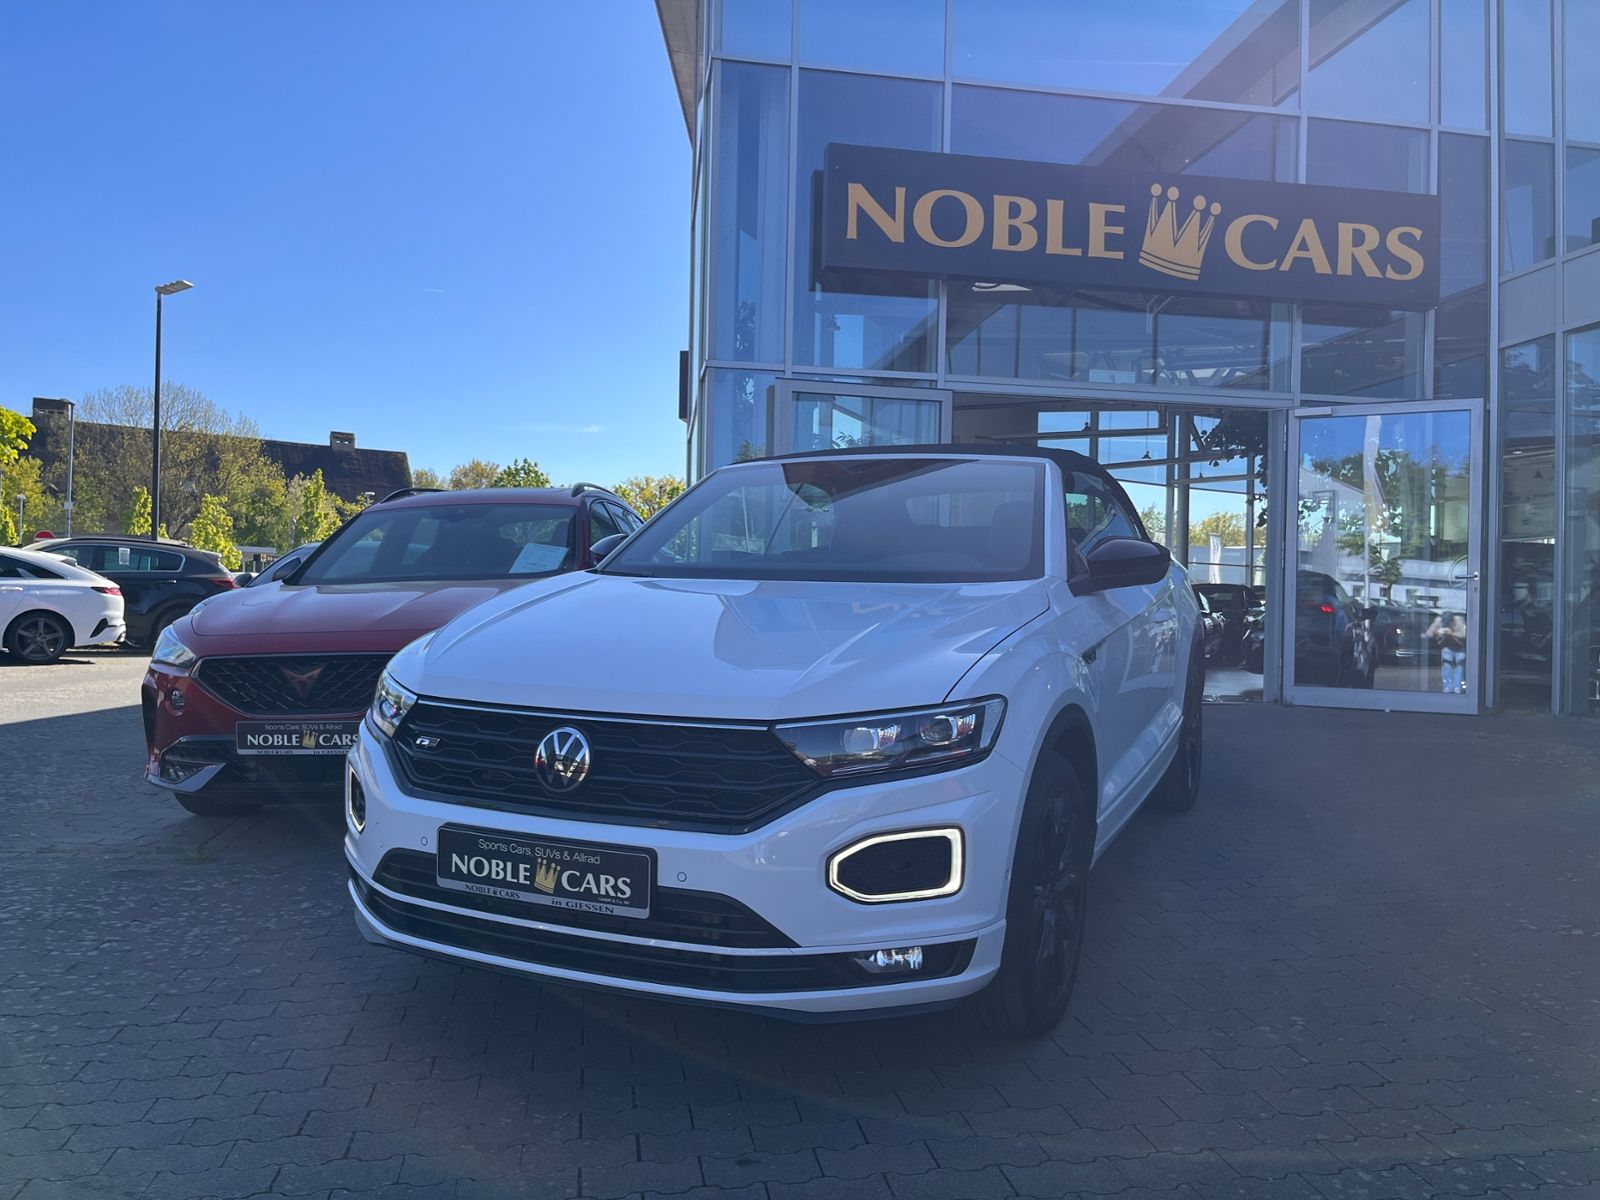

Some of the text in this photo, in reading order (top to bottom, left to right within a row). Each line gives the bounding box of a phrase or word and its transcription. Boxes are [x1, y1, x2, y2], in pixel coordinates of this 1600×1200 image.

[845, 181, 1426, 282] NOBLE CARS
[247, 734, 300, 746] NOBLE
[478, 838, 508, 852] Sports
[534, 846, 561, 860] SUVs
[562, 851, 571, 861] &
[573, 852, 600, 865] Allrad
[451, 853, 632, 899] NOBLE CARS
[465, 883, 521, 899] NOBLE CARS
[551, 898, 562, 907] in
[565, 900, 614, 914] GIESSEN
